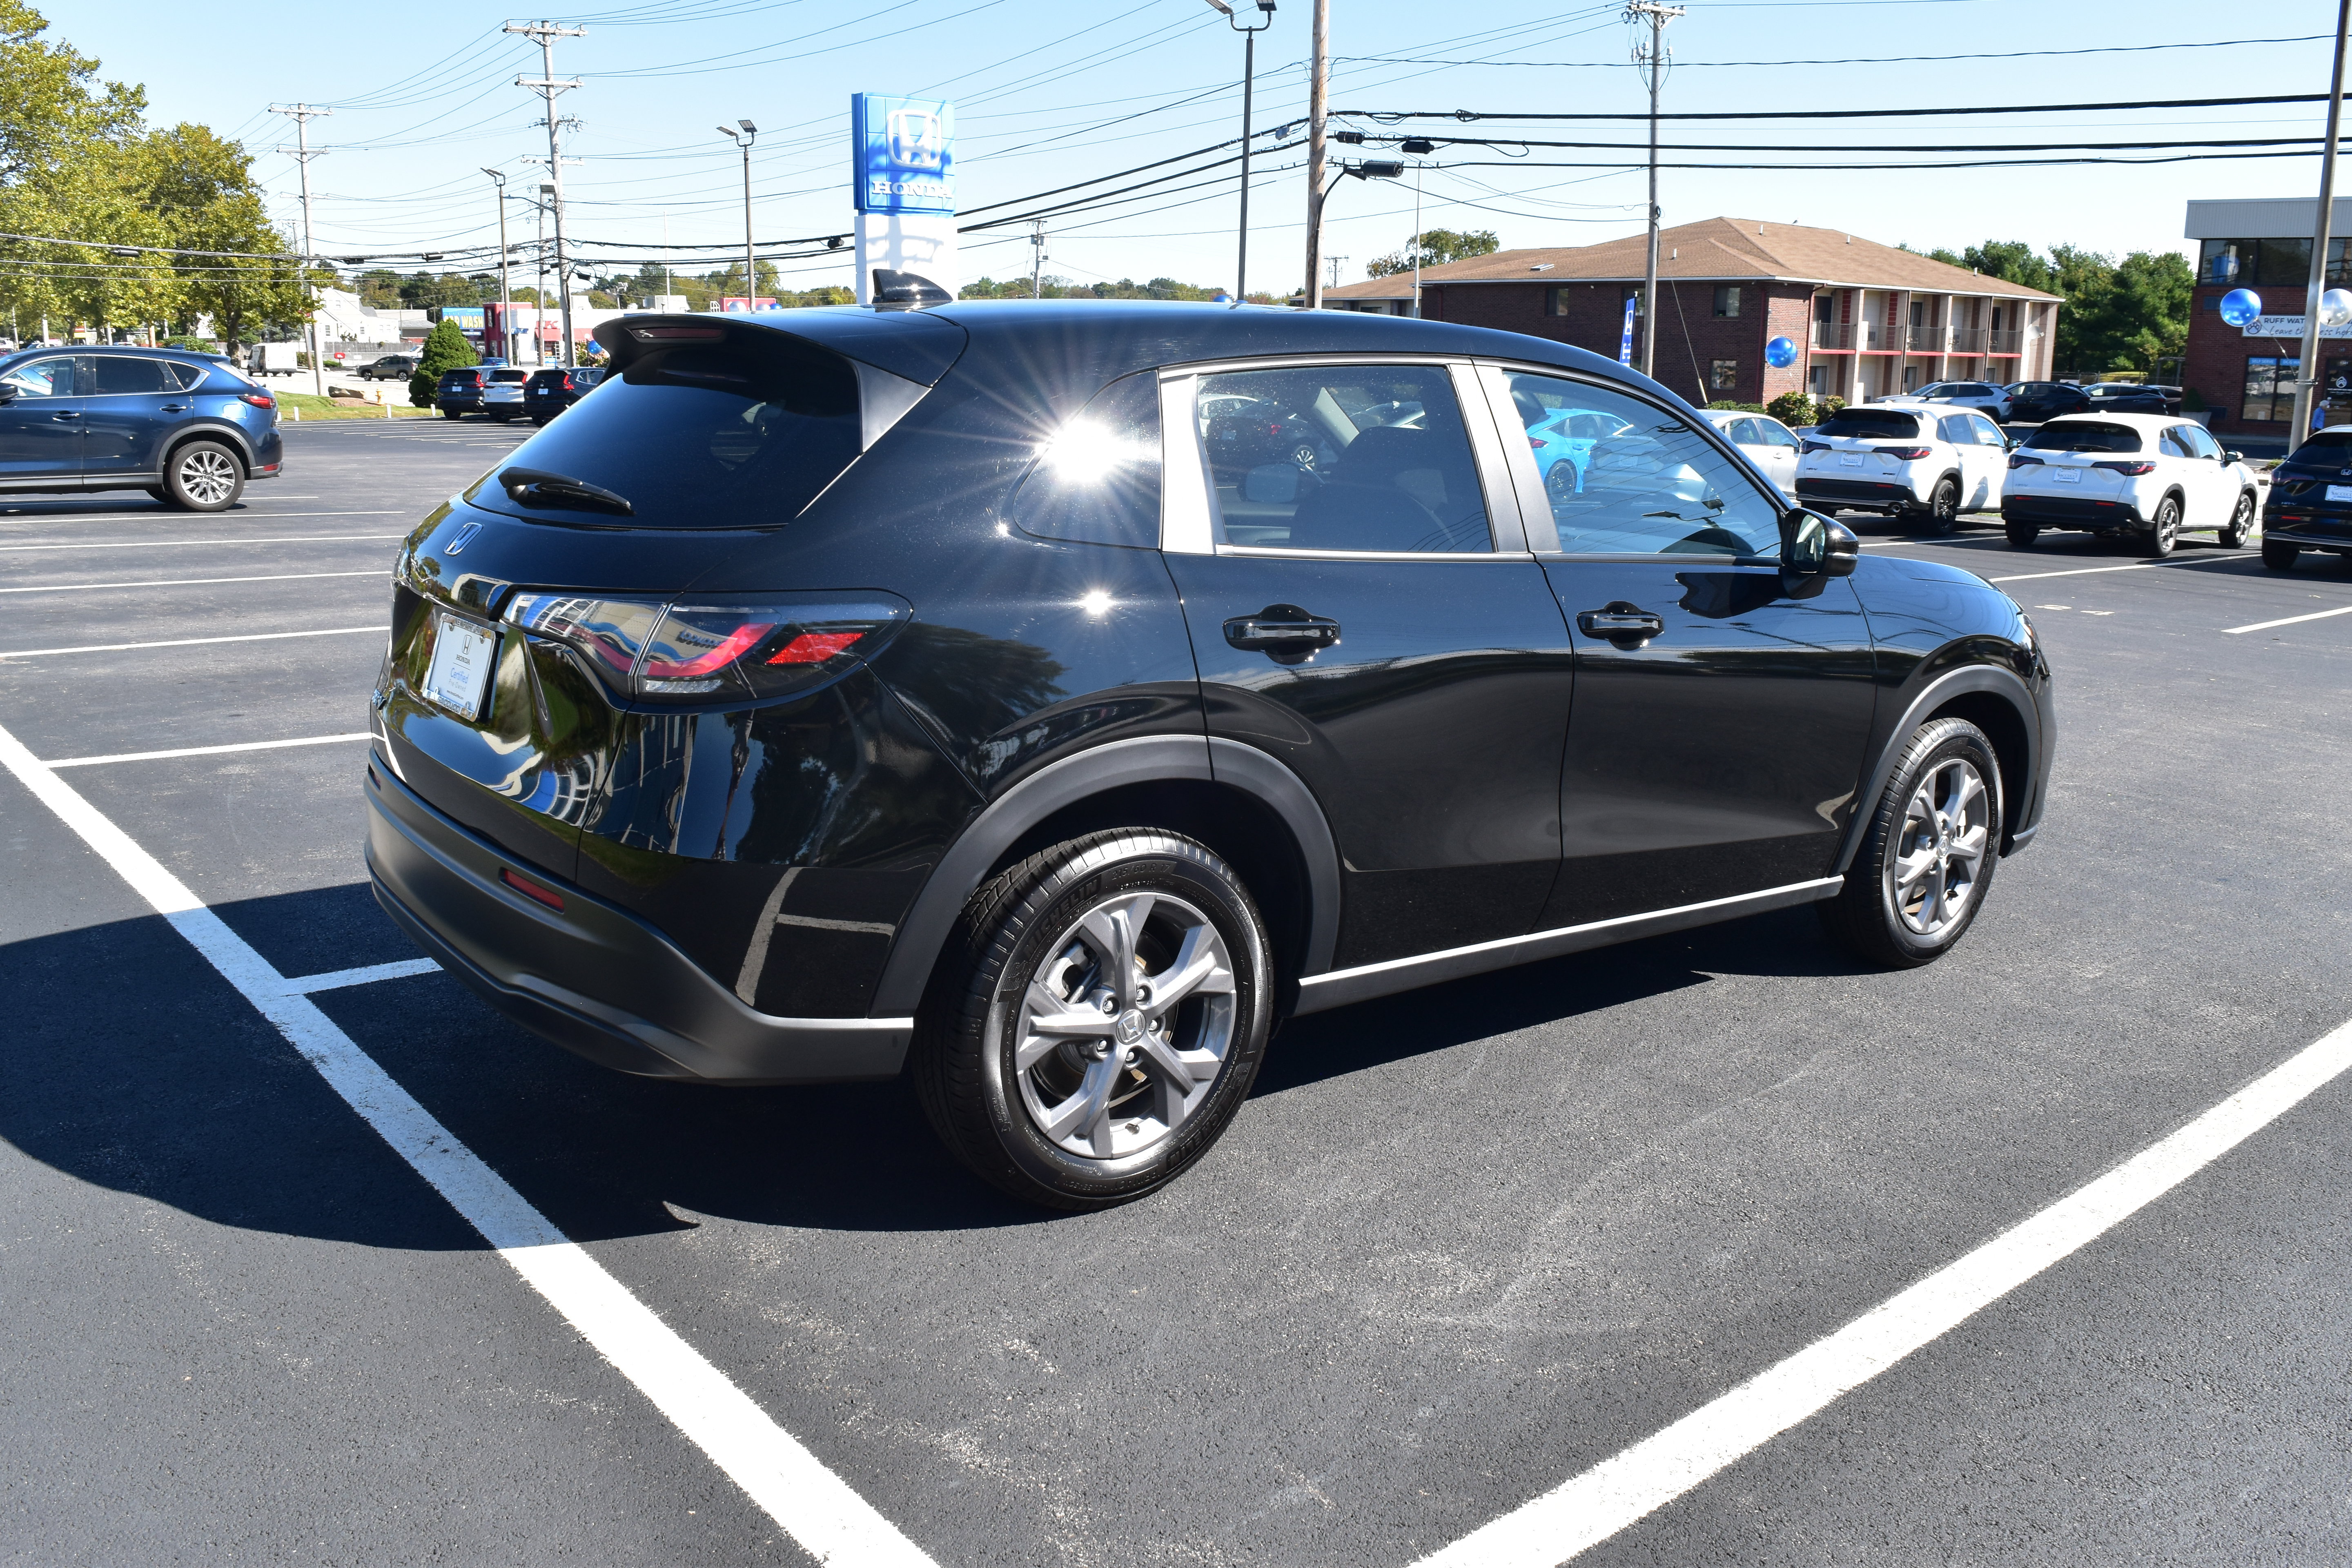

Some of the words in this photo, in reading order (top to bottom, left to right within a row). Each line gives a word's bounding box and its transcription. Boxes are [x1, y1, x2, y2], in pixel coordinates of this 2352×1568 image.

[872, 180, 953, 199] HONDA
[461, 316, 483, 328] WASH
[2270, 326, 2292, 335] Leave
[456, 654, 470, 665] HONDA
[450, 667, 469, 684] Certified
[449, 678, 466, 692] Pre-Owned
[438, 696, 461, 715] SACCUCCI
[1111, 864, 1146, 880] 215/60
[1149, 863, 1156, 872] R
[1161, 864, 1170, 873] 17
[1022, 879, 1098, 958] MICHELIN
